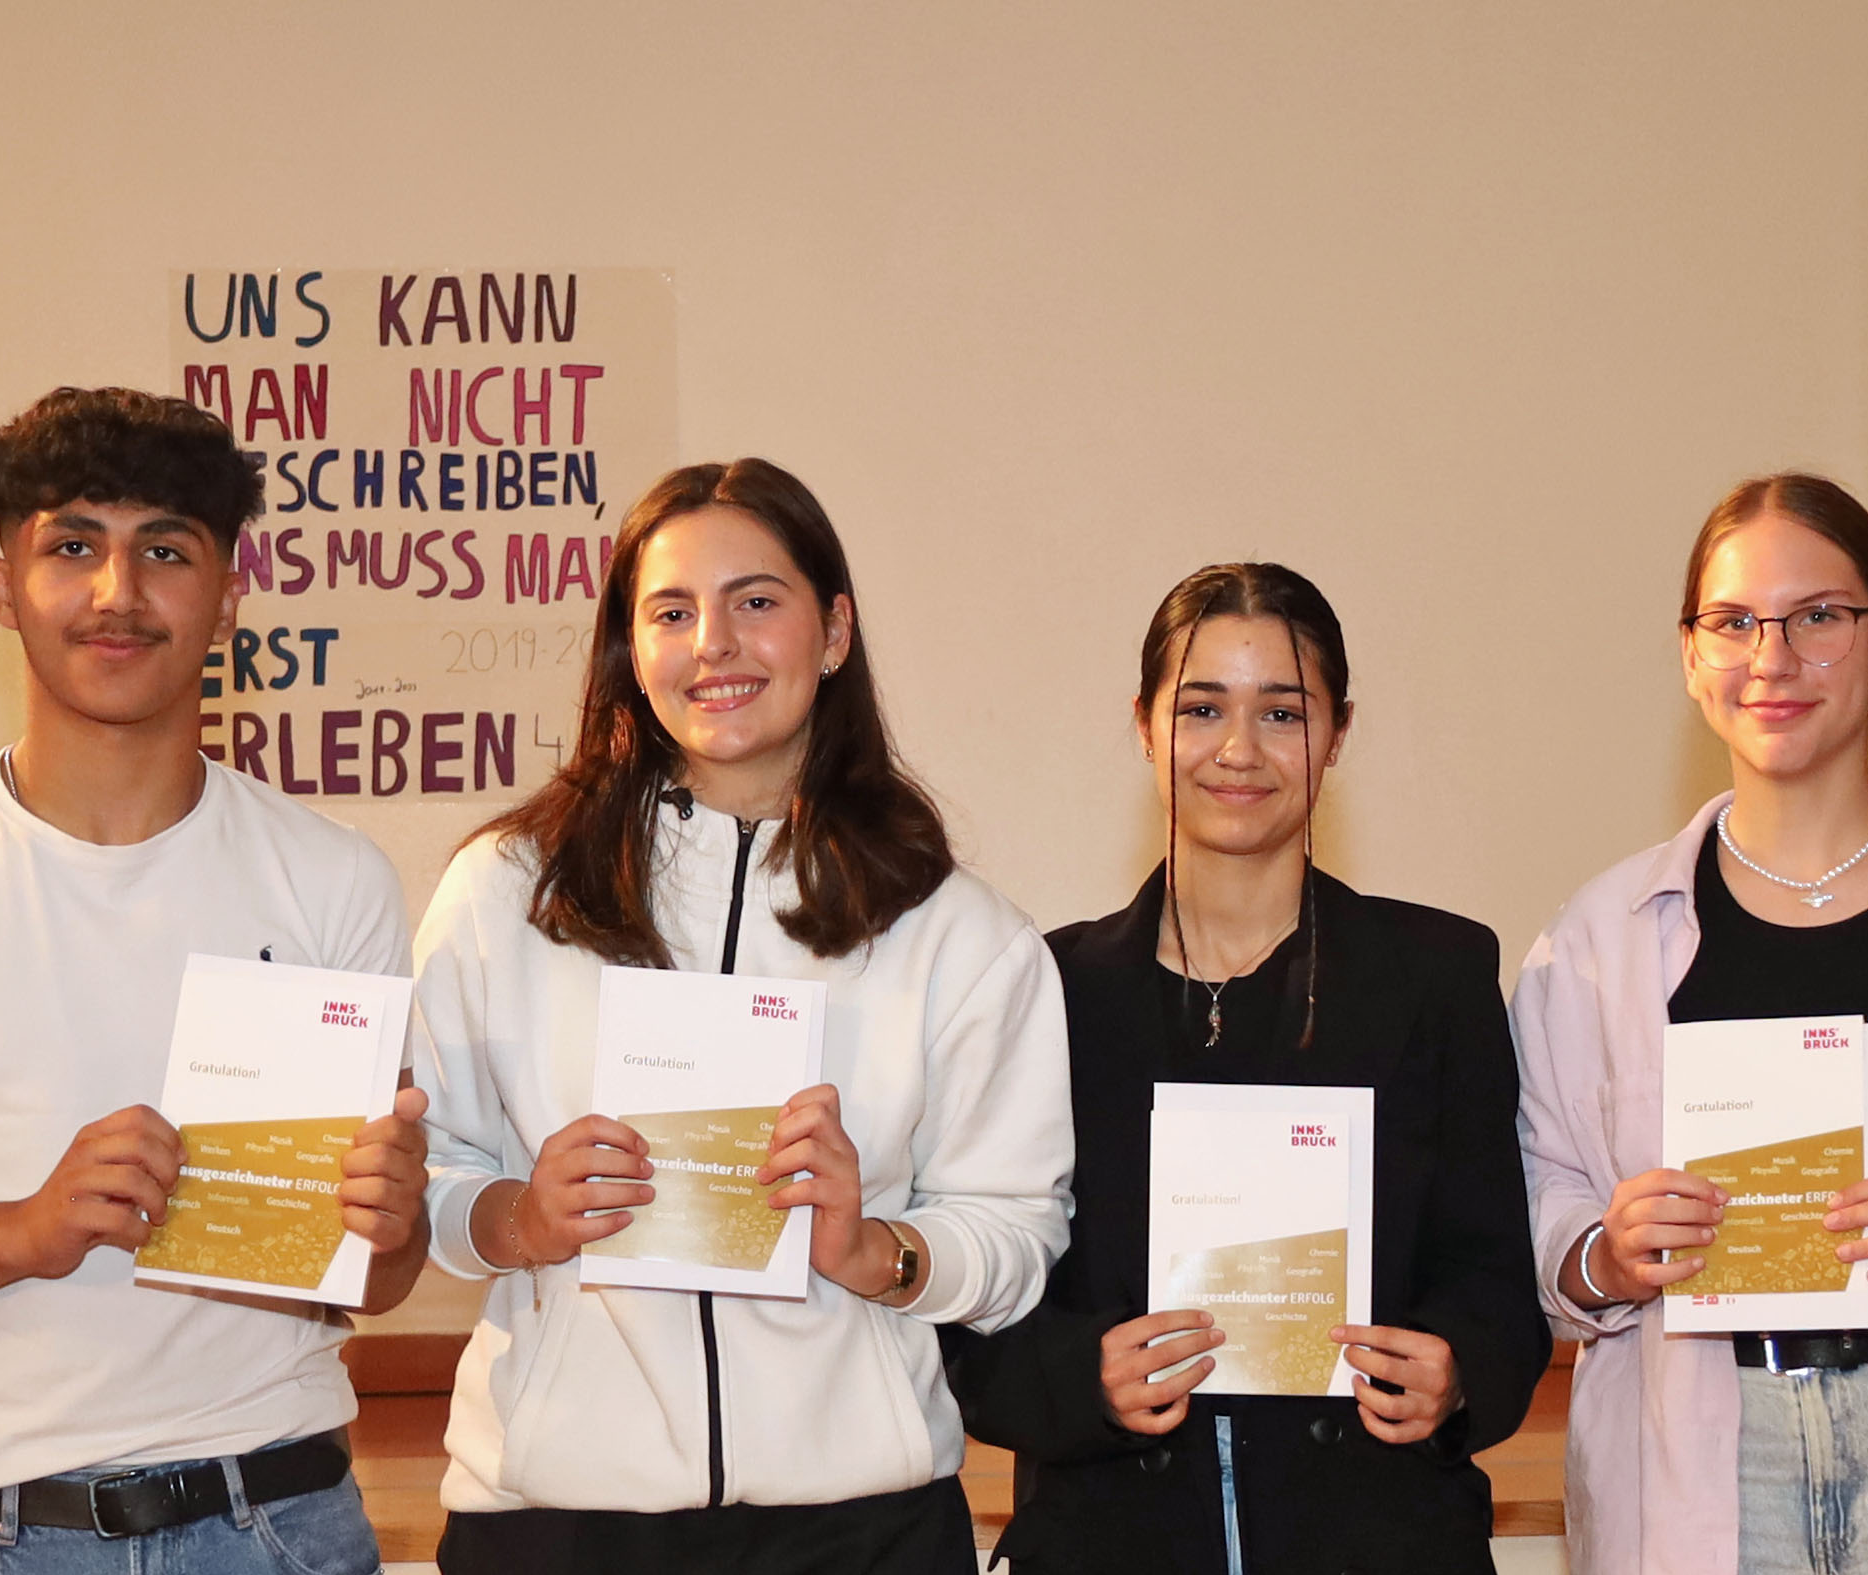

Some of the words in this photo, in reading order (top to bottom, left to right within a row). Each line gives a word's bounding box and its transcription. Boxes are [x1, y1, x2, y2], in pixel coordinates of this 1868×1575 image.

[185, 271, 331, 347] UNS
[379, 273, 578, 347] KANN
[184, 363, 329, 442] MAN
[408, 364, 605, 447] NICHT
[229, 528, 316, 596] NS
[327, 528, 486, 600] MUSS
[321, 1012, 369, 1028] BRUCK
[751, 1006, 798, 1020] BRUCK
[1803, 1038, 1849, 1049] BRUCK
[623, 1053, 694, 1070] Gratulation!
[189, 1060, 260, 1079] Gratulation!
[1683, 1098, 1753, 1112] Gratulation!
[1291, 1136, 1336, 1146] BRUCK
[179, 1165, 292, 1189] ausgezeichneter
[1171, 1194, 1241, 1205] Gratulation!
[205, 1222, 242, 1235] Deutsch
[1290, 1292, 1335, 1304] ERFOLG
